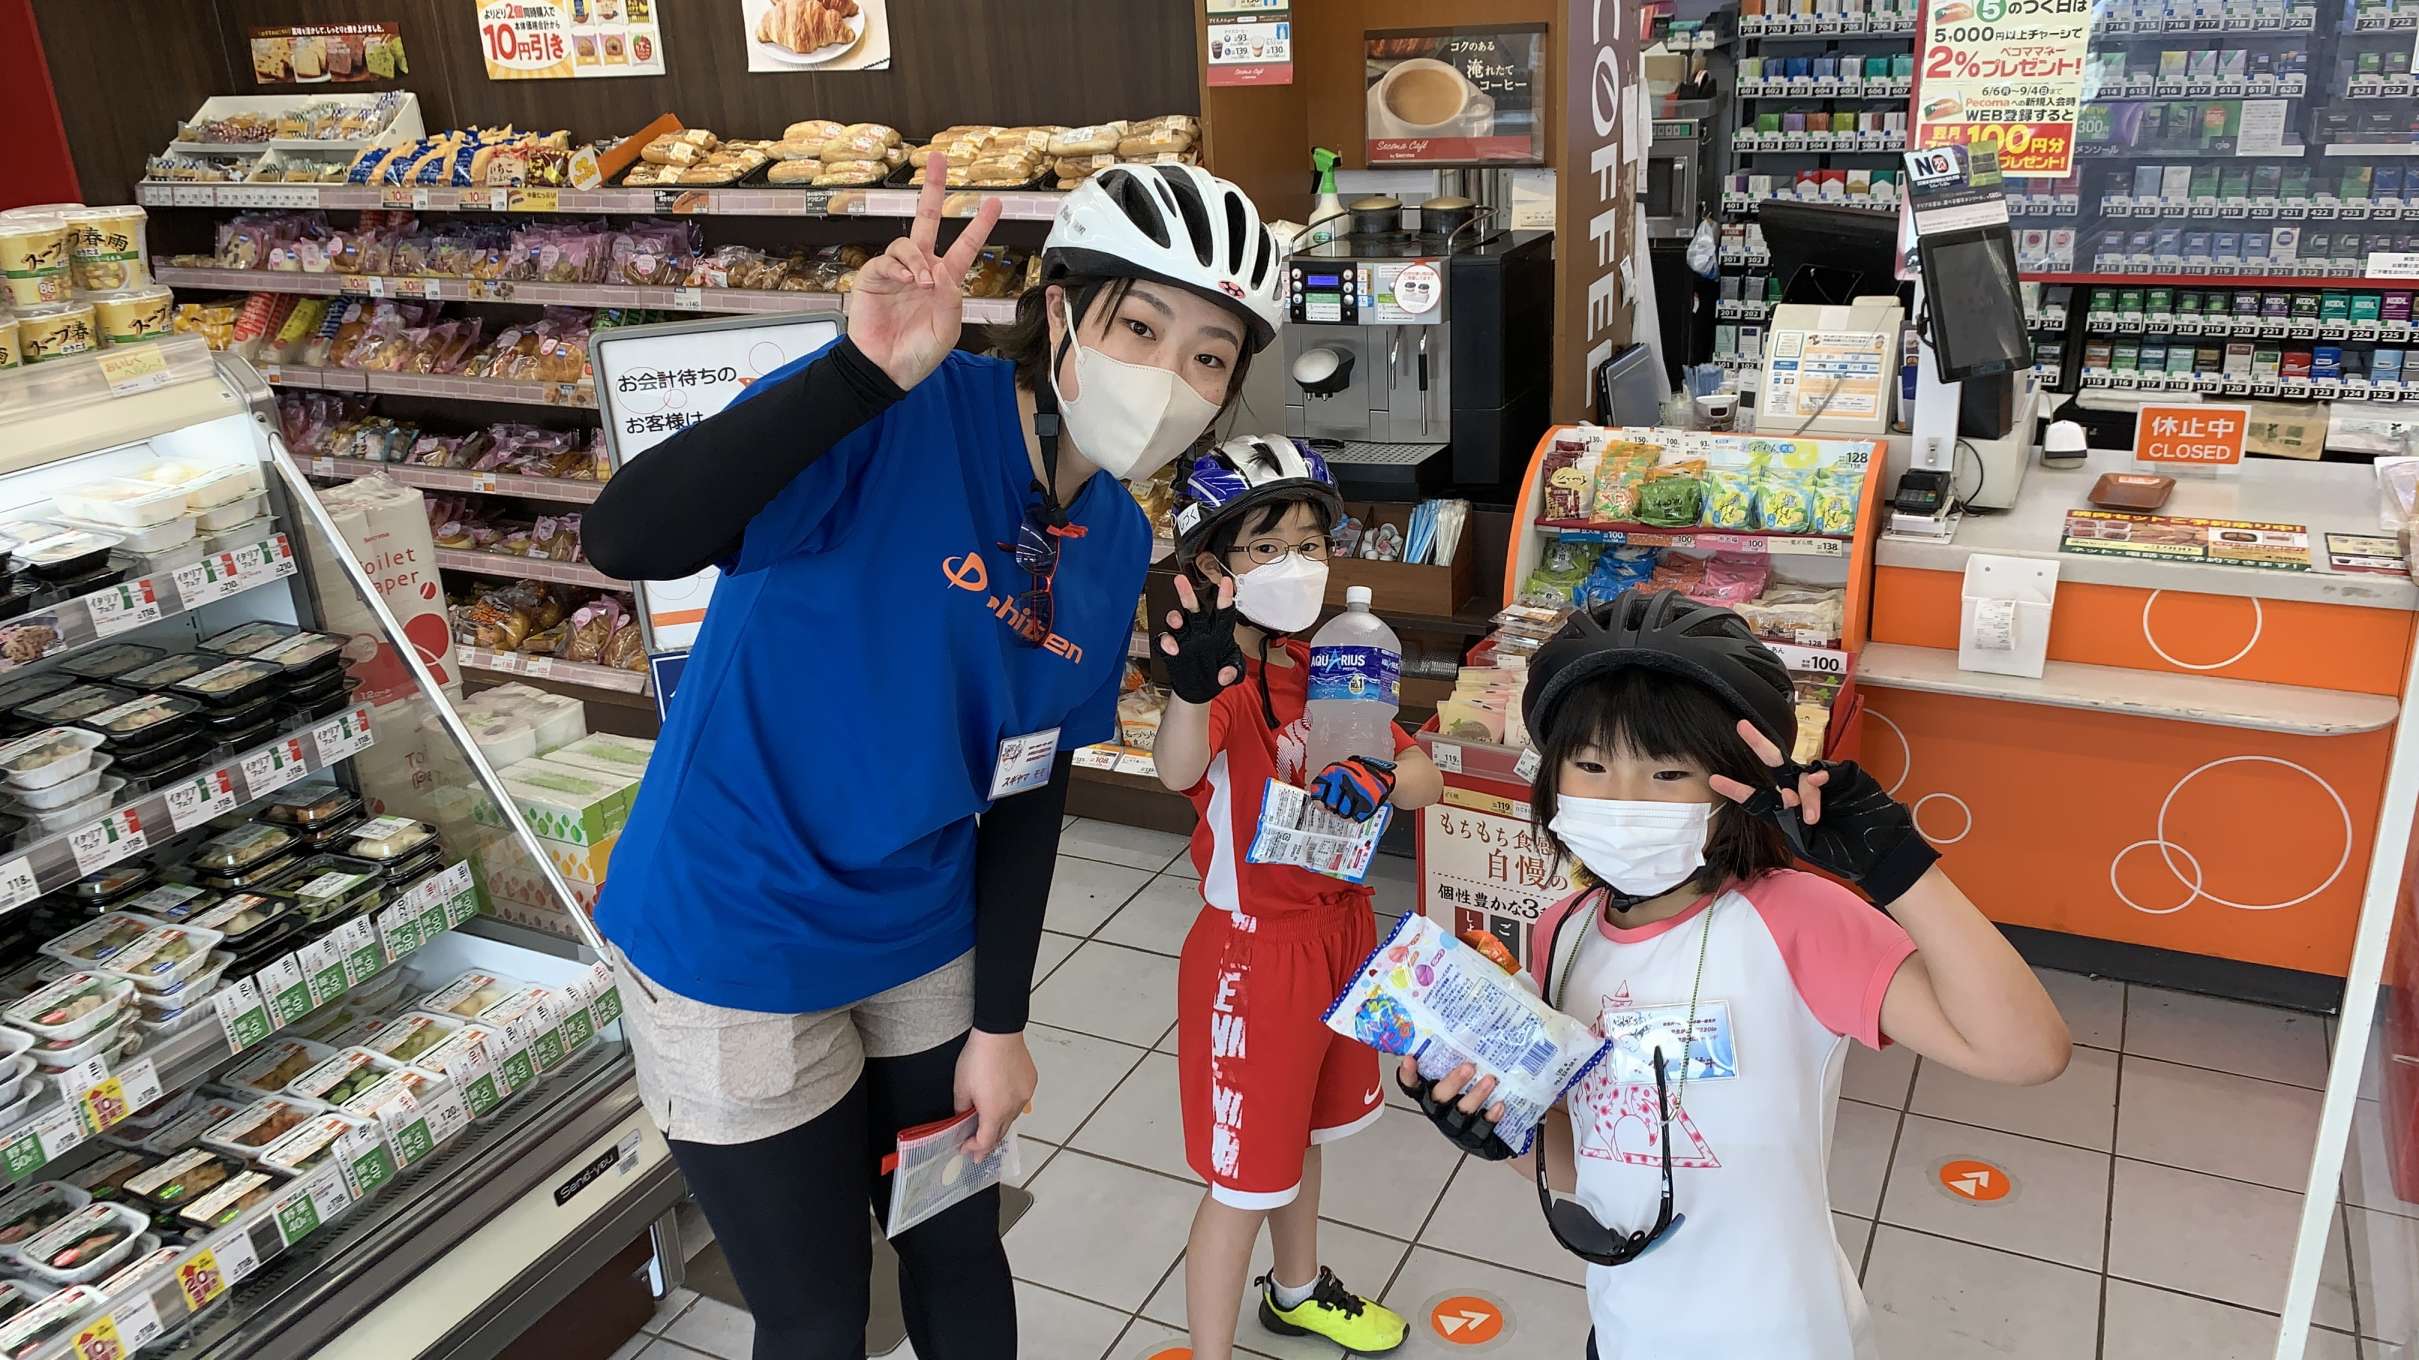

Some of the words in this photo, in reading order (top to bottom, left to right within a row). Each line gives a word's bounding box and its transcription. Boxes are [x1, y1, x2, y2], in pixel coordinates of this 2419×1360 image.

[1933, 26, 2083, 43] 5,000円以上チャージで
[482, 24, 565, 61] 10円引き
[1450, 40, 1496, 54] コクのある
[1925, 45, 2082, 79] 2%プレゼント!
[1466, 58, 1515, 79] 淹れたて
[1478, 78, 1529, 92] コーヒー
[1965, 109, 2074, 123] WEB登録すると
[2251, 208, 2269, 216] 420
[1721, 309, 1735, 317] 201
[1744, 309, 1759, 317] 202
[2042, 320, 2059, 328] 214
[2118, 322, 2136, 330] 216
[2147, 323, 2165, 331] 217
[2232, 326, 2251, 334] 220
[2262, 327, 2279, 335] 221
[2291, 328, 2309, 336] 222
[2322, 329, 2340, 337] 223
[2352, 330, 2371, 338] 224
[2381, 331, 2400, 339] 225
[617, 366, 738, 393] お会計待ちの
[2113, 378, 2129, 387] 116
[2140, 380, 2157, 388] 117
[2169, 381, 2186, 389] 118
[2196, 382, 2213, 390] 119
[2226, 384, 2243, 392] 120
[2254, 385, 2271, 394] 121
[2283, 387, 2300, 395] 122
[2313, 388, 2331, 396] 123
[2344, 389, 2361, 397] 124
[2373, 390, 2390, 399] 125
[2151, 415, 2235, 440] 休止中
[2148, 442, 2232, 462] CLOSED
[1846, 452, 1868, 464] 128
[360, 548, 417, 575] oilet
[373, 570, 419, 596] aper
[1310, 648, 1366, 674] AQUARIUS
[1810, 656, 1840, 672] 100
[1487, 848, 1569, 892] 自慢の
